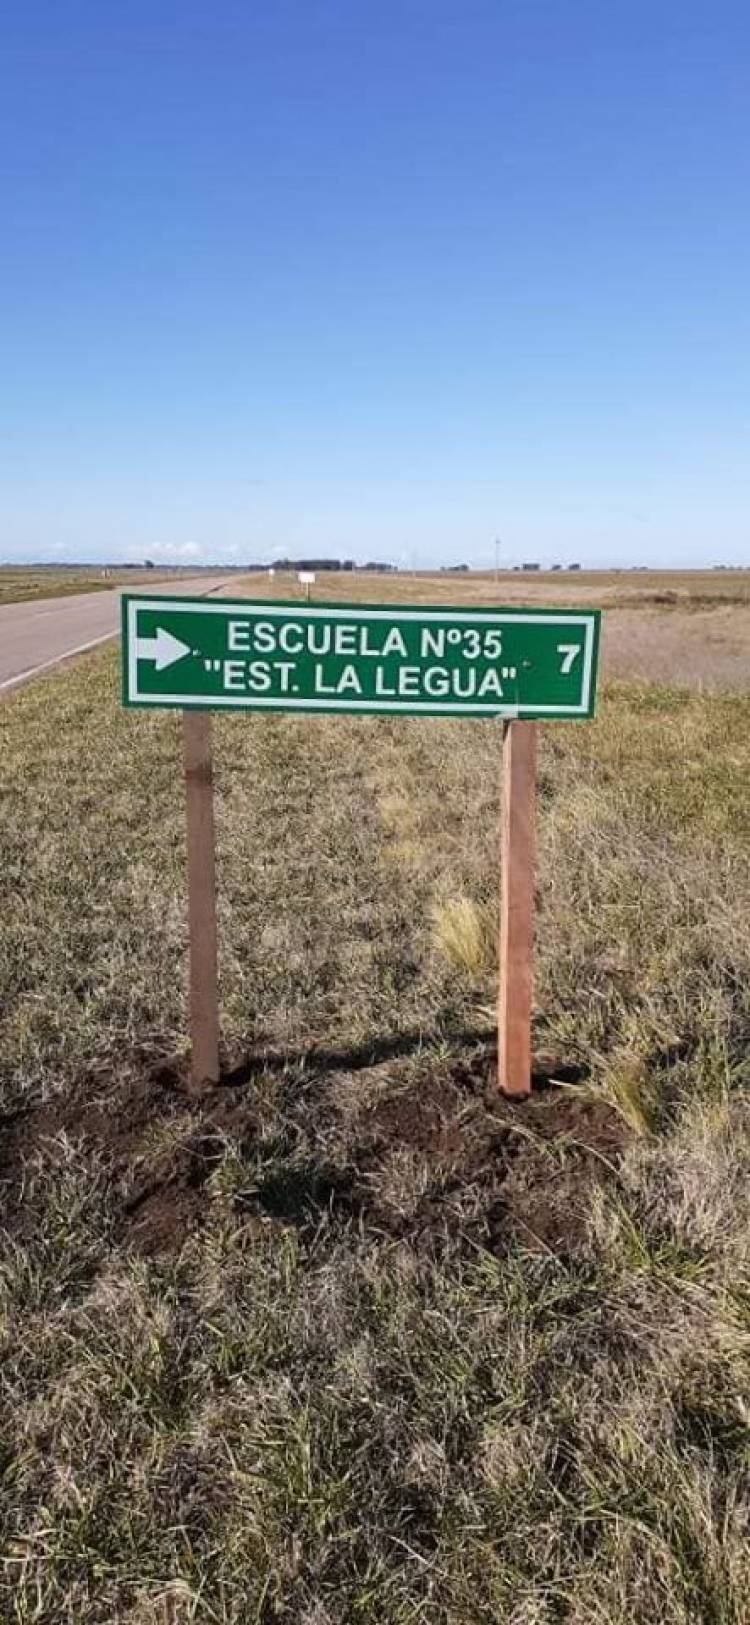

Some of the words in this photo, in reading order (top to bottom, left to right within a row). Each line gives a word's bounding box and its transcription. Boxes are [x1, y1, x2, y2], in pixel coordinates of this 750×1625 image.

[228, 621, 407, 657] ESCUELA
[557, 644, 581, 673] 7
[204, 659, 299, 692] "EST.
[315, 664, 362, 694] LA
[375, 666, 517, 698] LEGUA"
